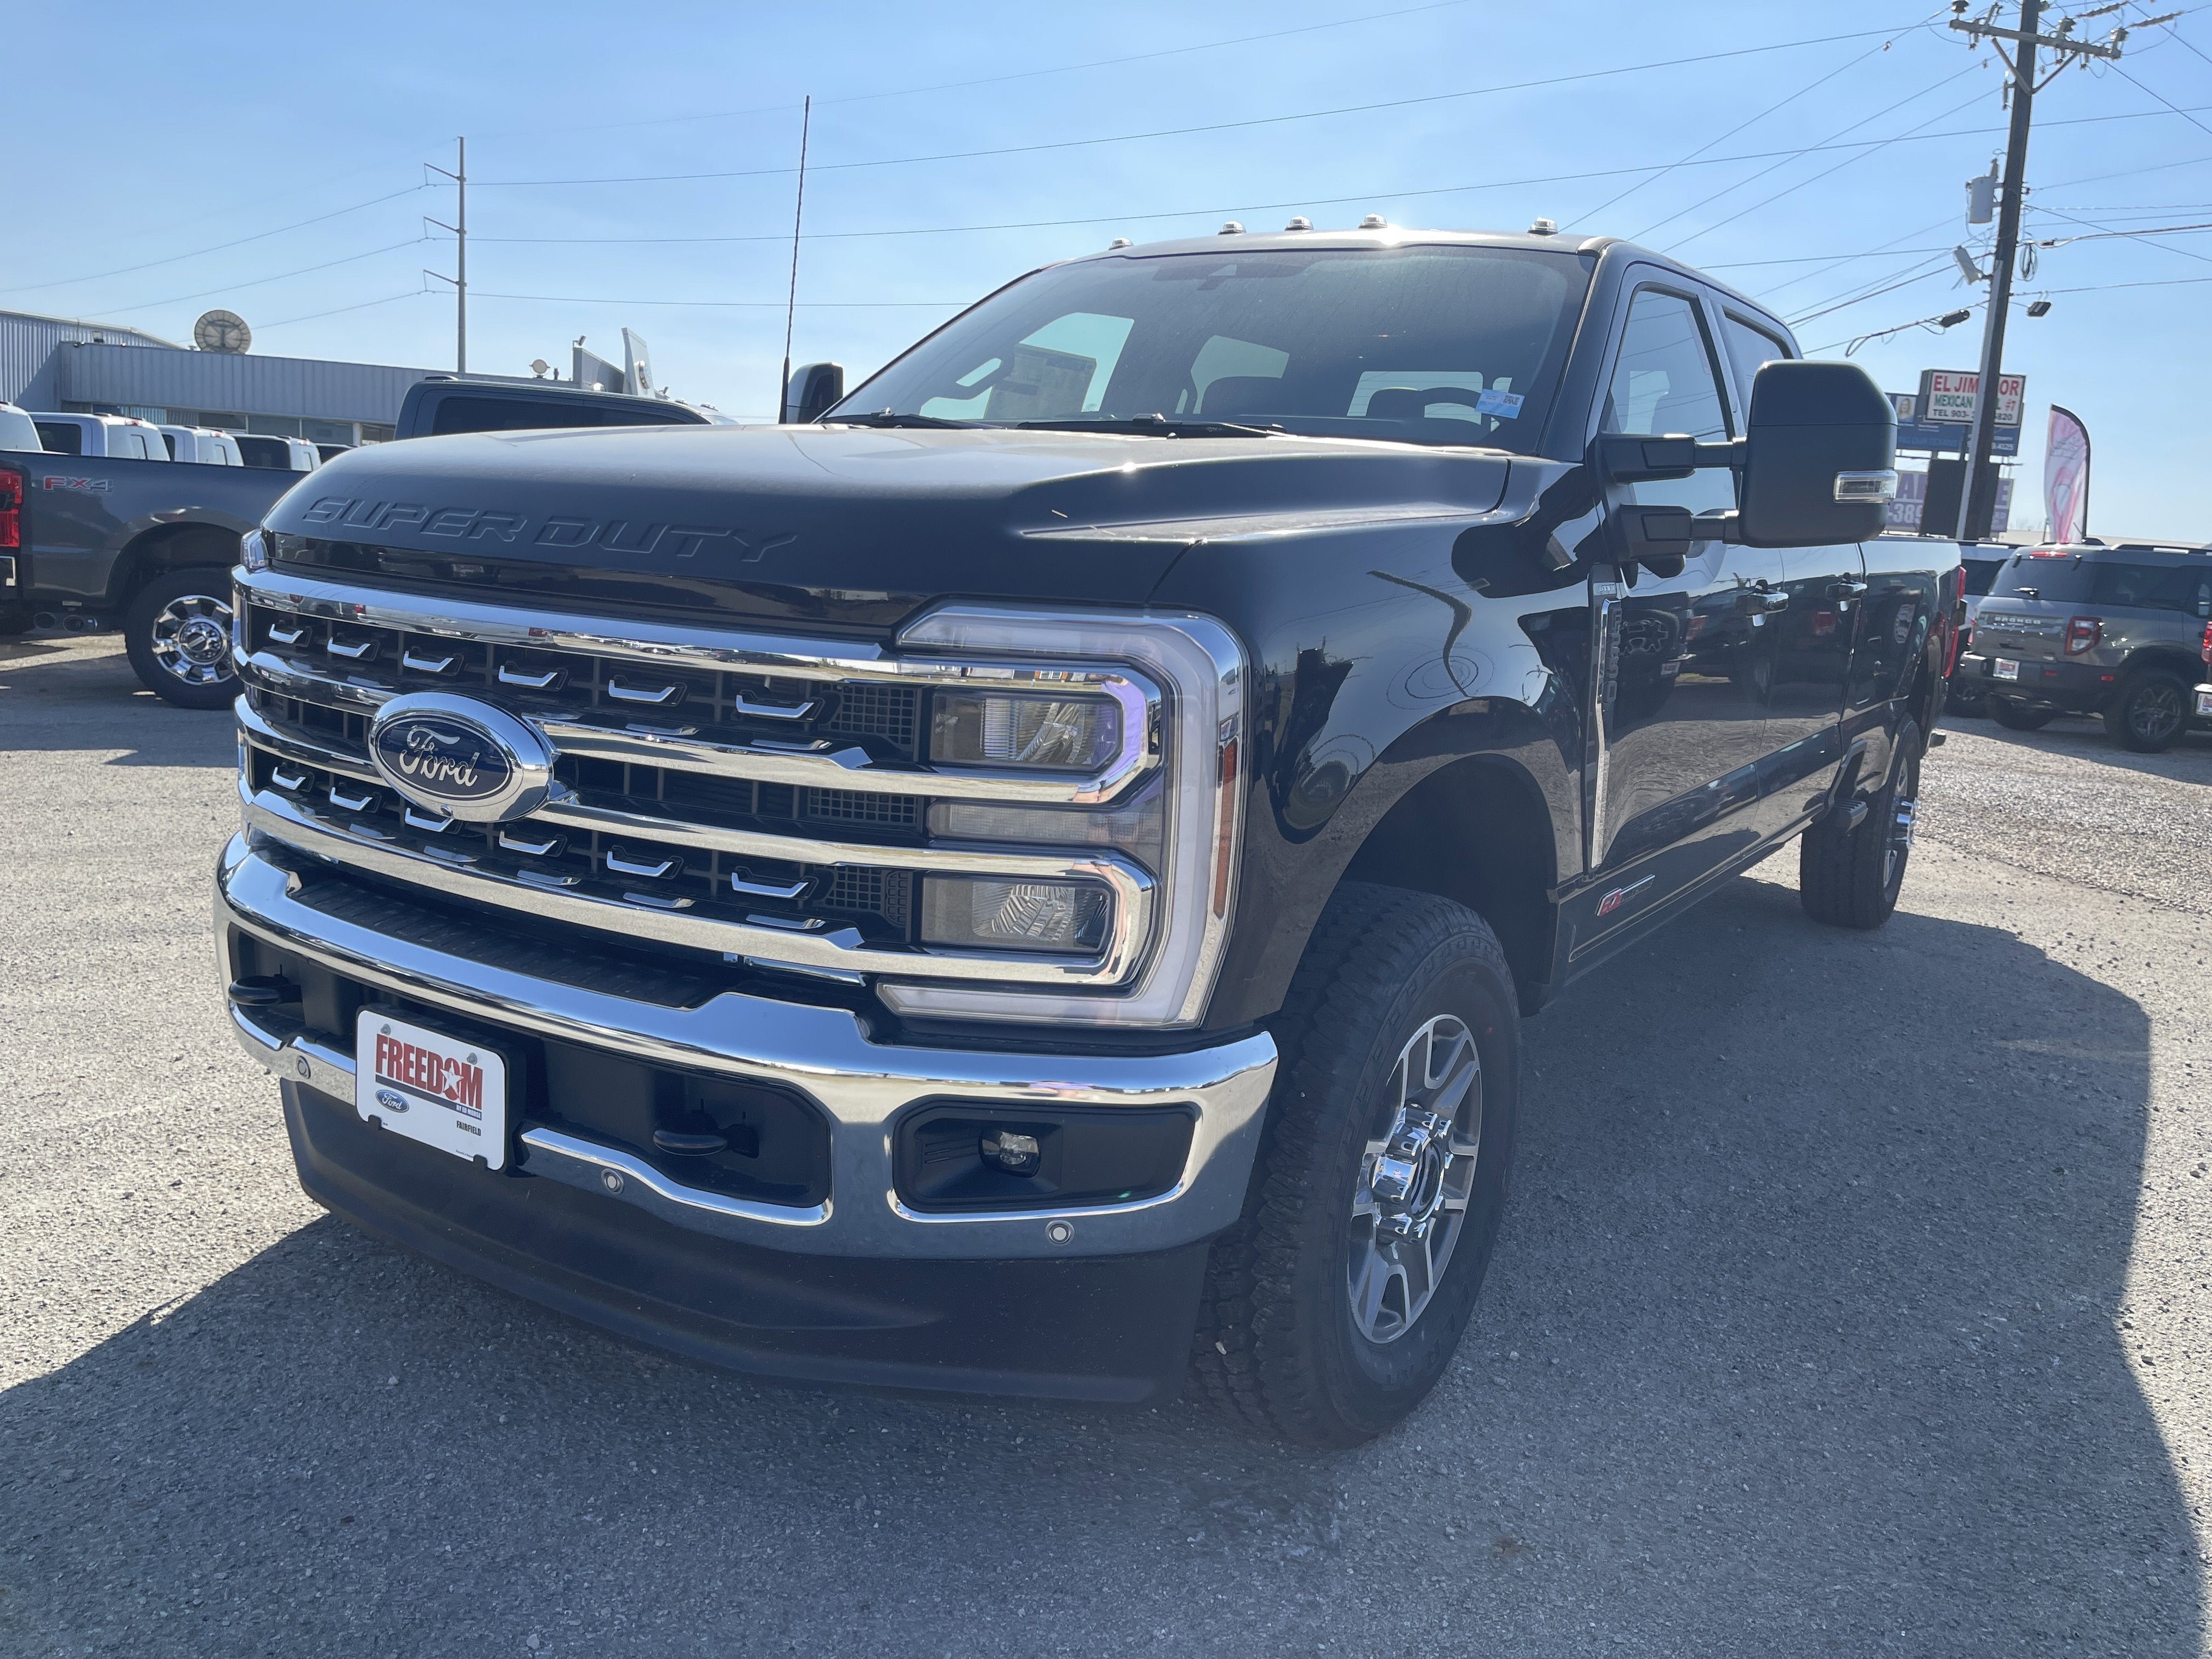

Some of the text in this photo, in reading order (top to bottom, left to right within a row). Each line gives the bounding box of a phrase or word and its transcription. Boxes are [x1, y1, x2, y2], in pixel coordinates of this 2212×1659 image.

[1933, 375, 2019, 396] EL JIMOR
[1934, 394, 1973, 408] MEXICAN
[1933, 409, 1948, 417] TEL
[43, 476, 113, 492] FX4
[302, 496, 798, 562] SUPER DUTY
[399, 725, 480, 787] Ford
[376, 1034, 483, 1110] FREEDOM
[382, 1093, 402, 1110] Ford
[456, 1120, 481, 1136] FAIRFIELD
